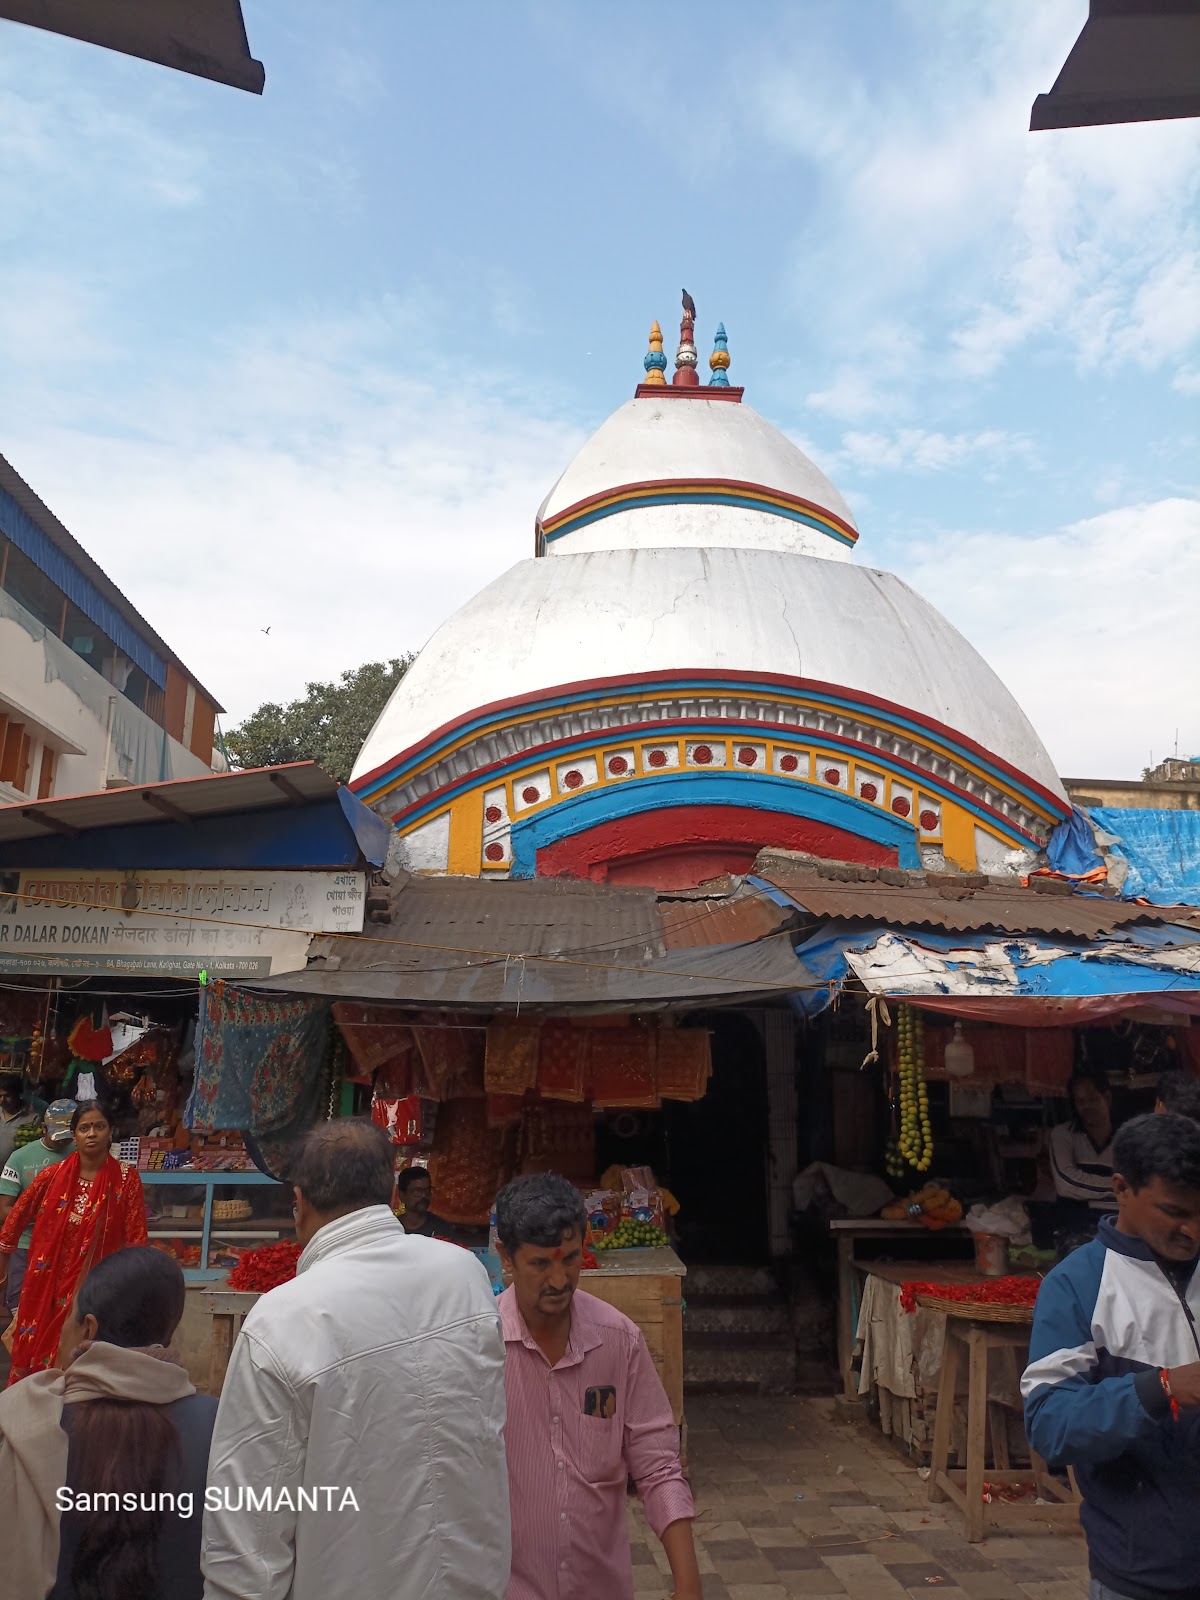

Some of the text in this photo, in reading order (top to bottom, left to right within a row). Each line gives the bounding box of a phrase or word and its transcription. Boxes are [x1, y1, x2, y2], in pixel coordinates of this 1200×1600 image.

[334, 875, 357, 885] এখানে
[194, 880, 272, 914] দোকান
[326, 889, 346, 900] খোয়া
[13, 925, 57, 943] DALAR
[62, 926, 109, 944] DOKAN
[114, 922, 159, 944] मेजदार
[106, 959, 115, 969] 6A,
[144, 960, 157, 970] Lane,
[159, 960, 181, 971] Kalighat,
[183, 961, 195, 969] Gate
[196, 961, 205, 970] No.
[215, 961, 234, 970] Kolkata
[239, 961, 248, 970] 700
[249, 961, 259, 970] 026
